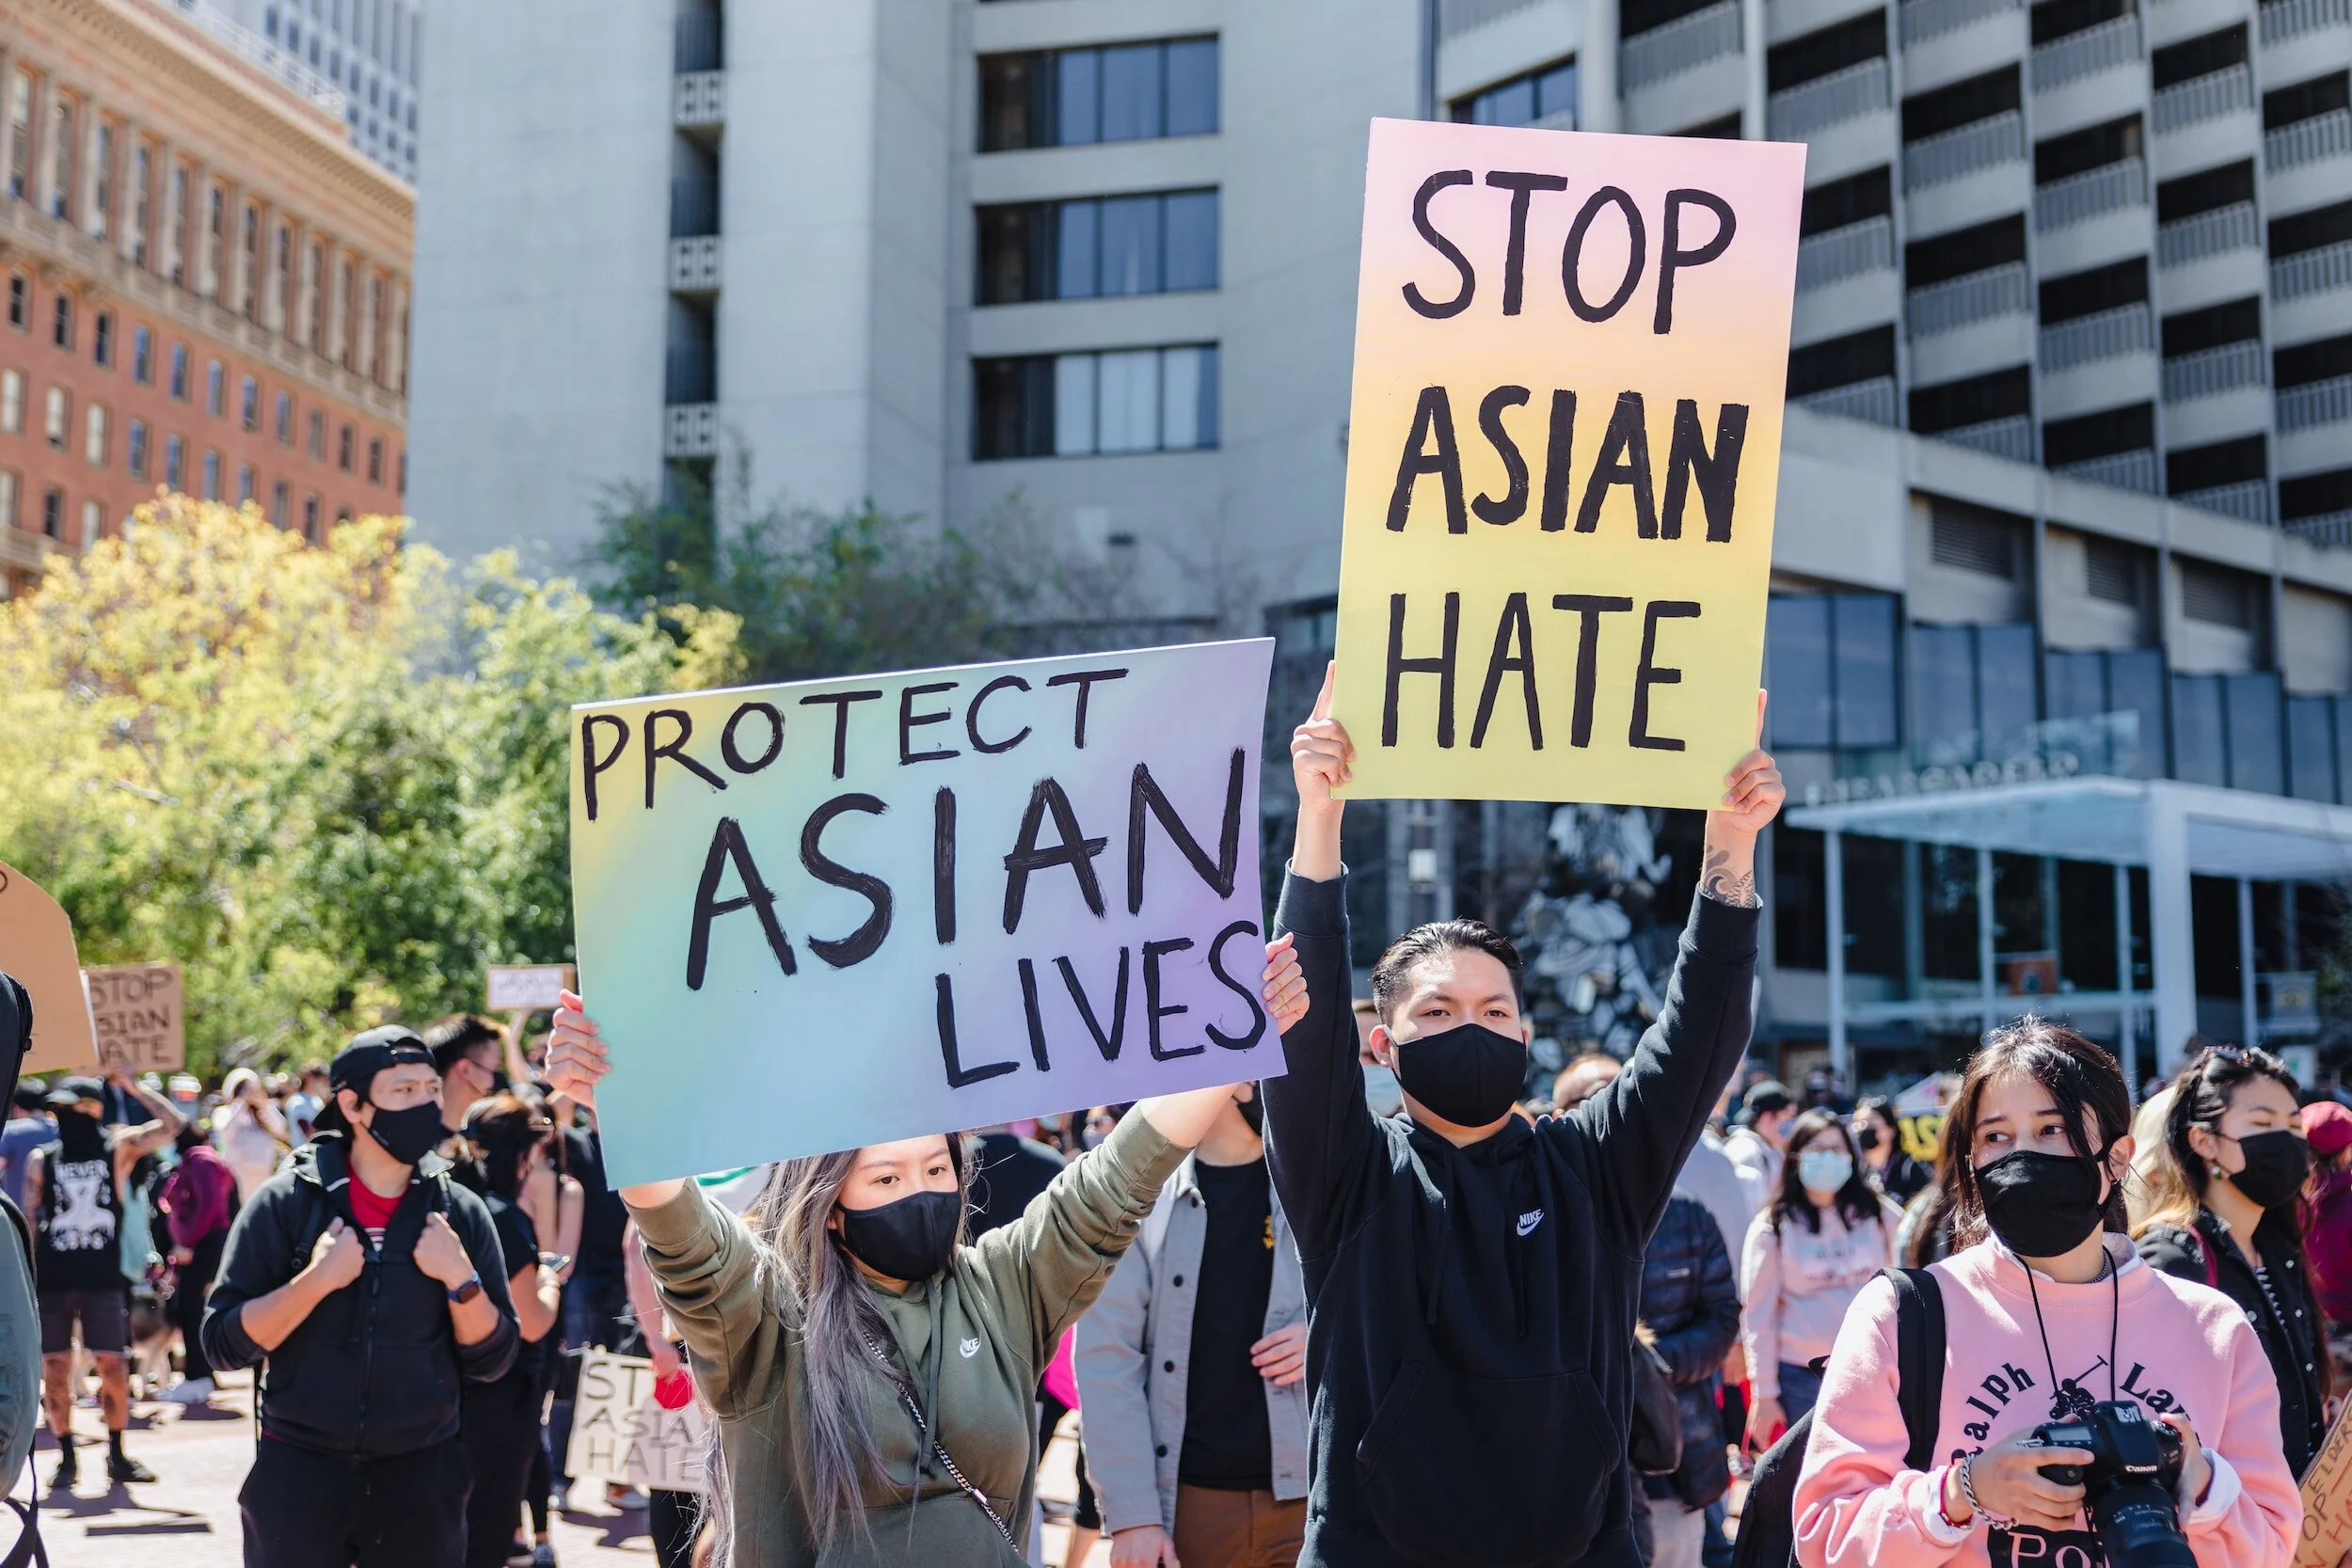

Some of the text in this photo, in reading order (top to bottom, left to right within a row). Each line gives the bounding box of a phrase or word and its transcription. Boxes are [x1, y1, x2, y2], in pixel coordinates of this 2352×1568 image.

[1402, 169, 1737, 335] STOP
[1386, 385, 1750, 544] ASIAN
[1381, 592, 1702, 752] HATE
[581, 668, 1129, 821] PROTECT
[686, 747, 1246, 991] ASIAN
[89, 968, 175, 1010] STOP
[934, 920, 1267, 1089] LIVES
[95, 1004, 170, 1037] SIAN
[99, 1036, 171, 1069] ATE
[1519, 1208, 1542, 1227] NIKE
[585, 1360, 650, 1406] ST
[583, 1406, 692, 1443] ASIA
[587, 1436, 705, 1481] HATE
[2124, 1465, 2157, 1473] Canon
